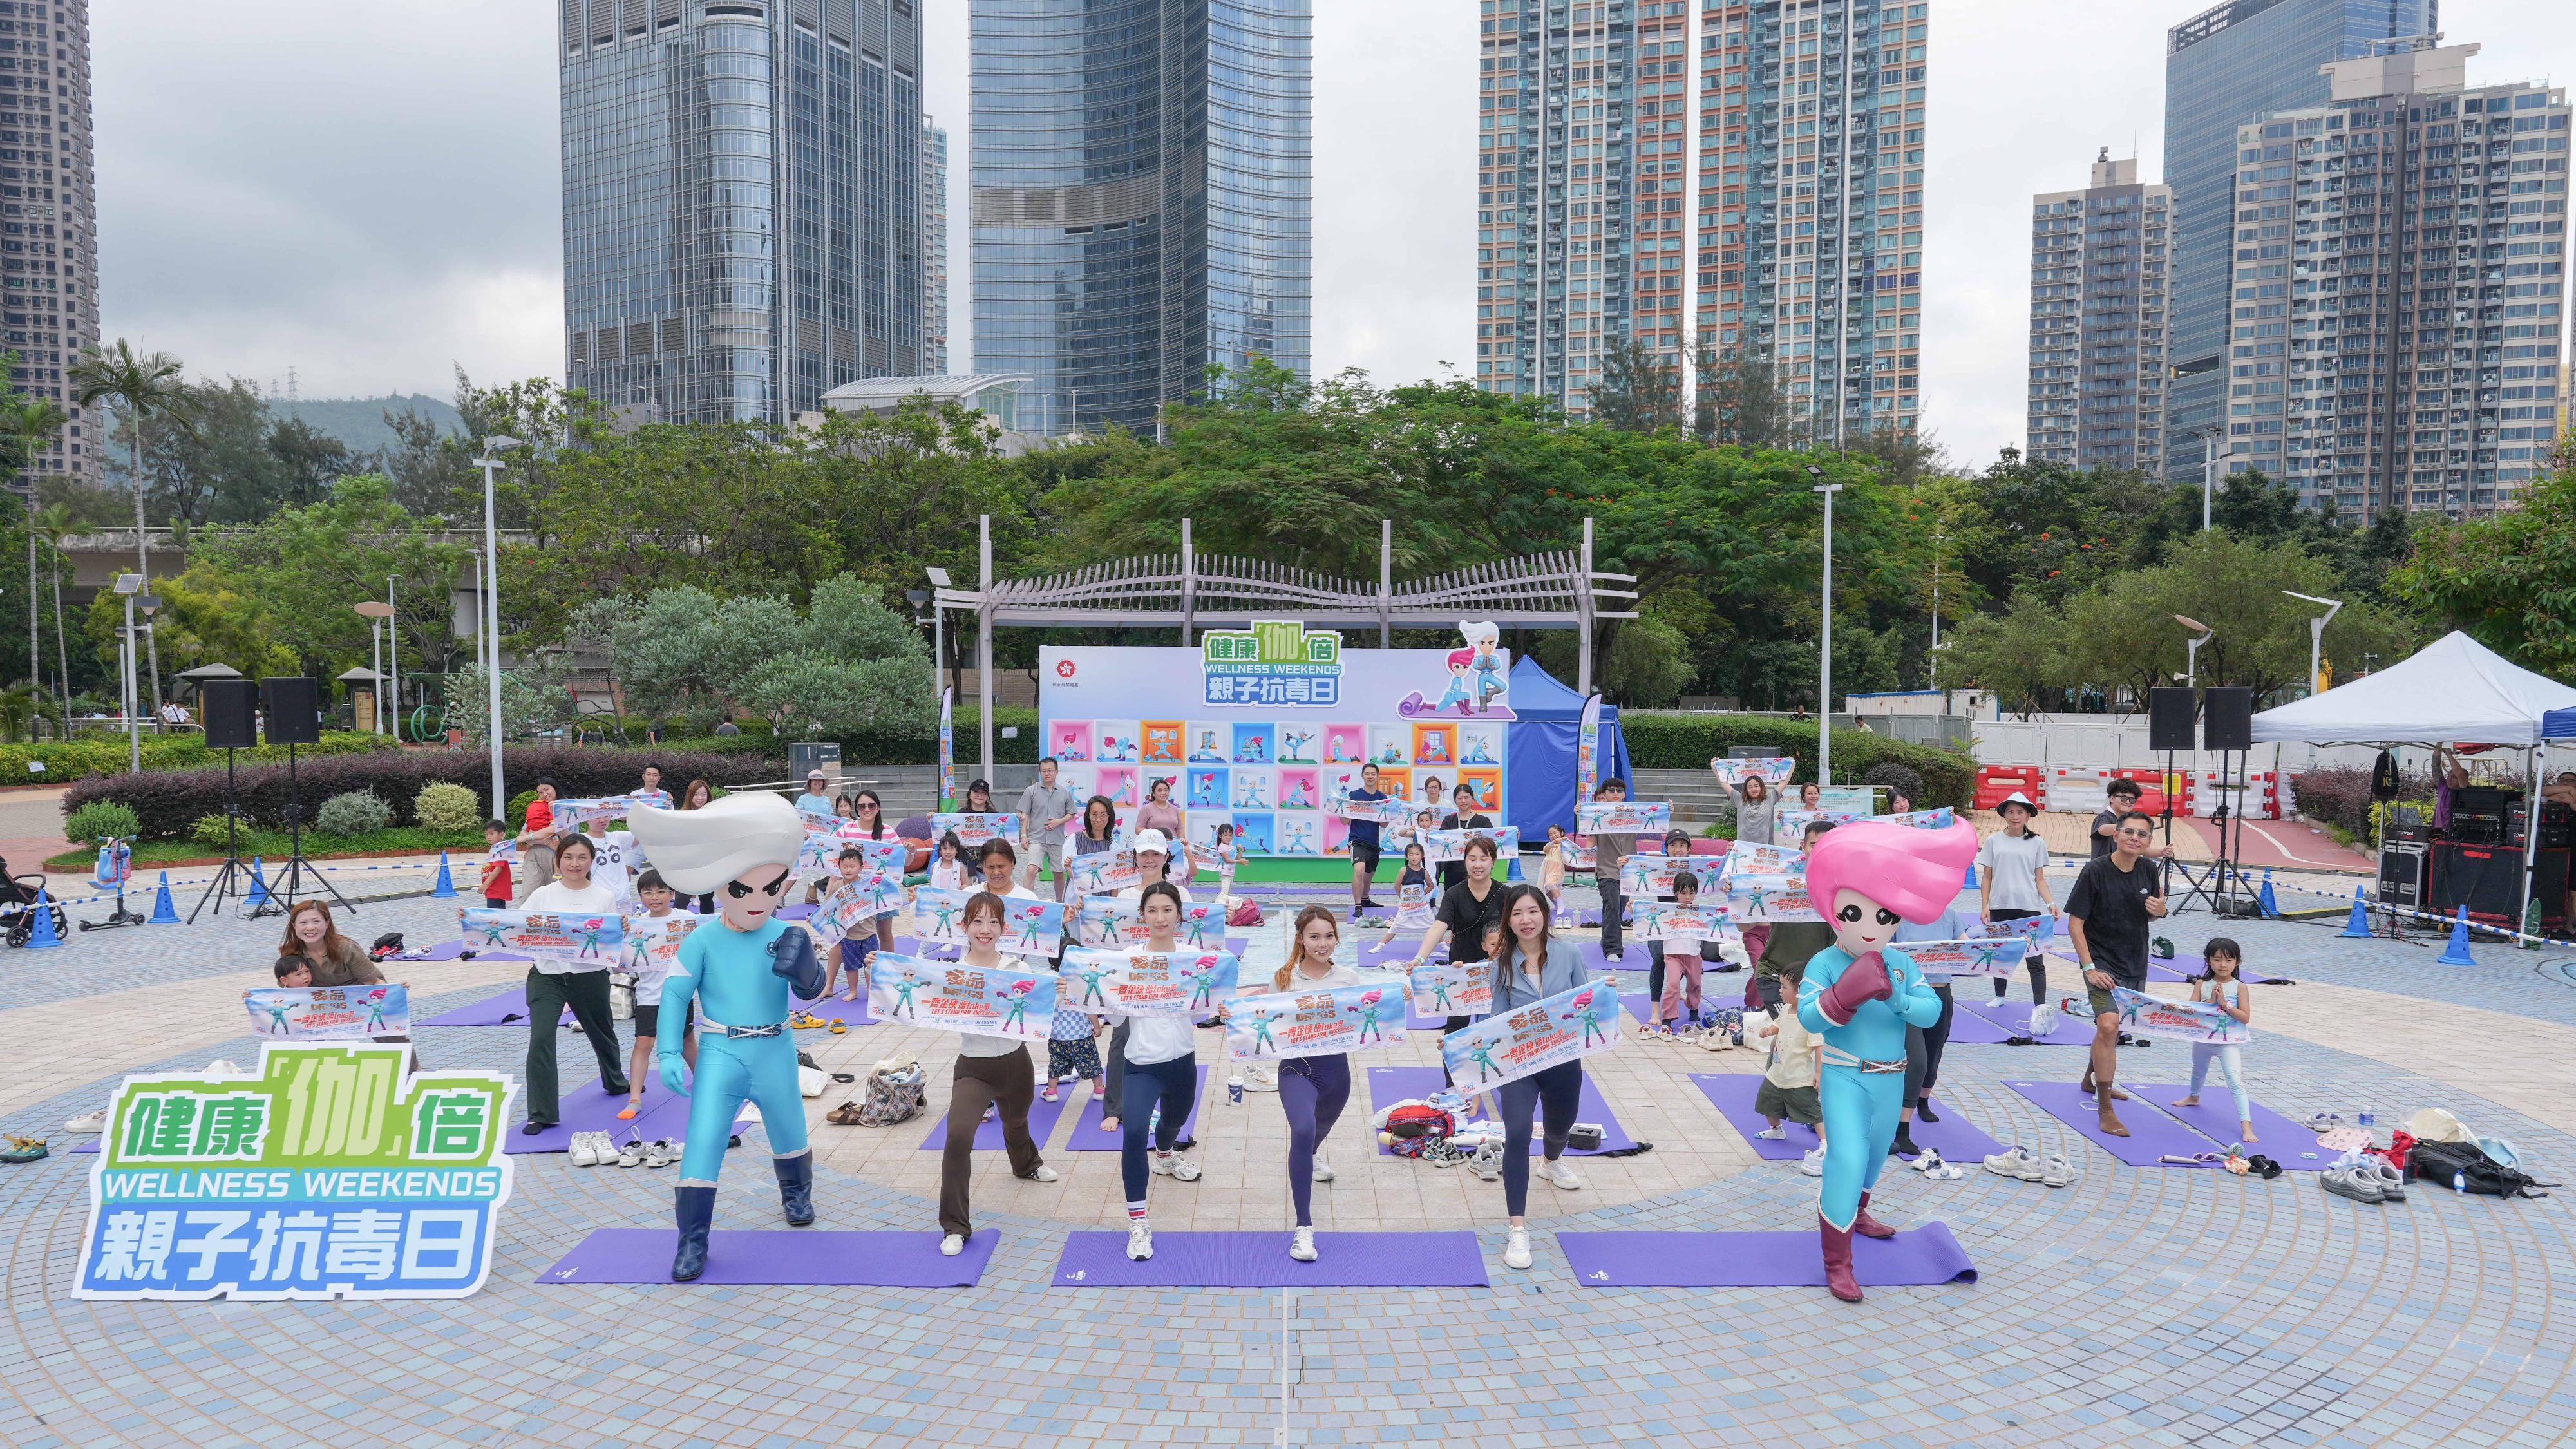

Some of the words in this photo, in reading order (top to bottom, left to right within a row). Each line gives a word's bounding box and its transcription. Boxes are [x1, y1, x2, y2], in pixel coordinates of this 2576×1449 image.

[1206, 664, 1270, 674] WELLNESS
[1274, 664, 1340, 674] WEEKENDS
[1209, 676, 1335, 701] 親子抗毒日
[1129, 955, 1169, 970] 毒品
[945, 969, 985, 989] 毒品
[1128, 972, 1169, 981] DRUGS
[943, 987, 984, 999] DRUGS
[311, 1002, 347, 1010] DRUGS
[1295, 994, 1334, 1011] 毒品
[1296, 1010, 1336, 1022] DRUGS
[1507, 1007, 1549, 1031] 毒品
[1303, 1033, 1317, 1041] STAND
[1513, 1023, 1553, 1043] DRUGS
[1515, 1056, 1526, 1064] LET'S
[1527, 1049, 1540, 1059] STAND
[105, 1171, 290, 1198] WELLNESS
[305, 1171, 497, 1197] WEEKENDS
[94, 1209, 479, 1282] 親子抗毒日
